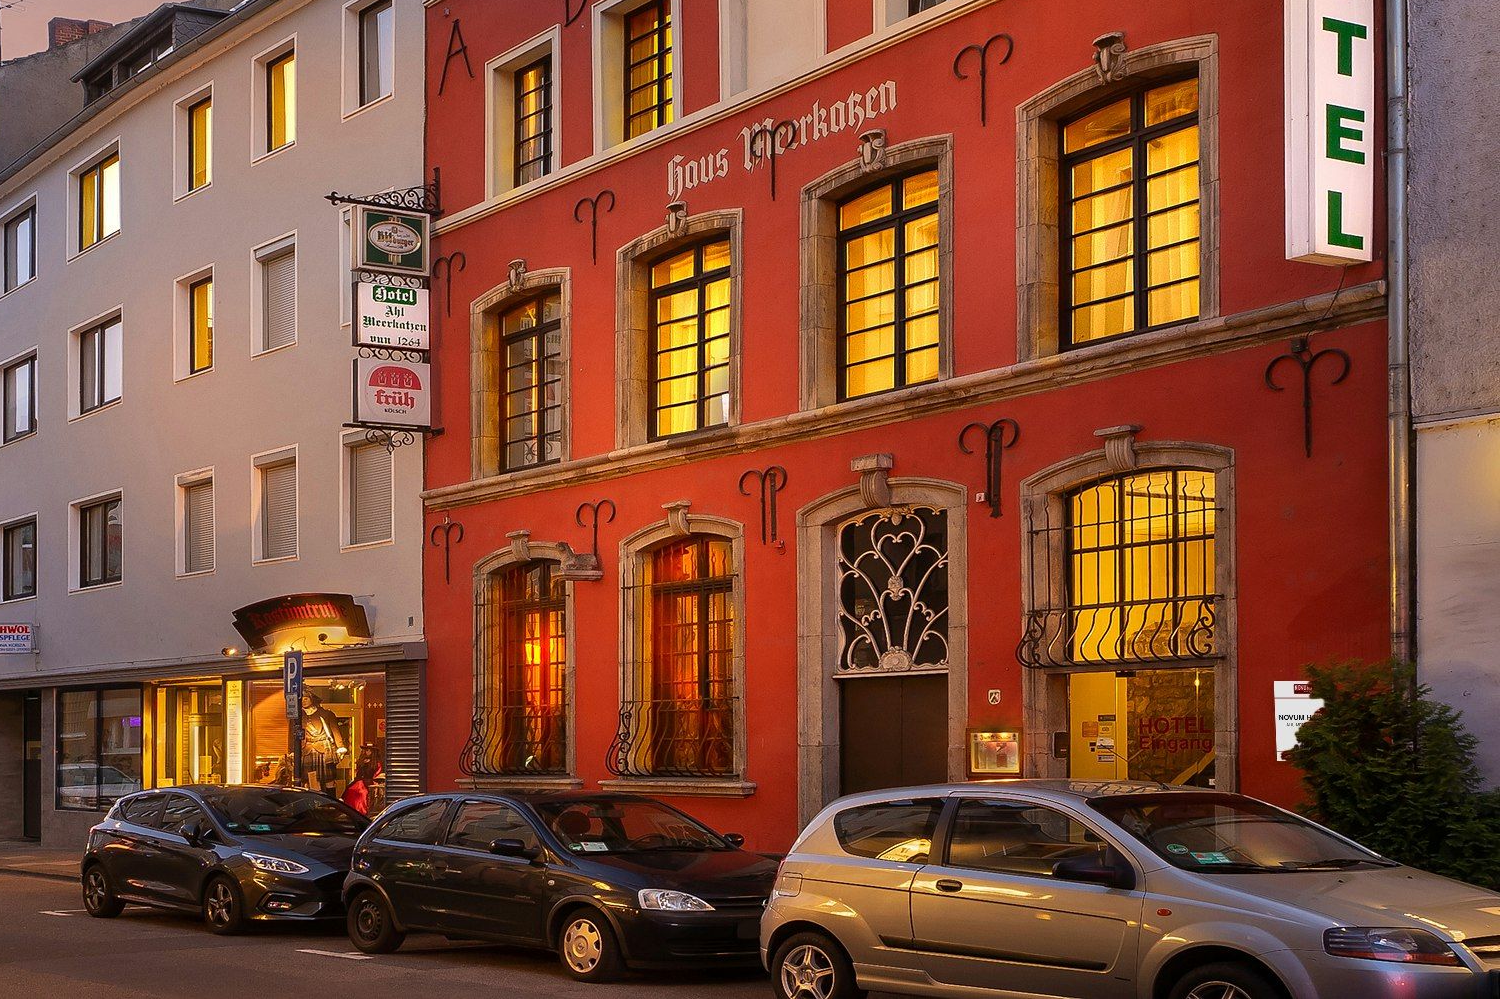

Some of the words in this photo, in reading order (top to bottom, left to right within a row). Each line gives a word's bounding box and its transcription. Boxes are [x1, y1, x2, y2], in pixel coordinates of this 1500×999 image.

[666, 146, 730, 202] Haus
[374, 286, 415, 303] Hotel
[397, 336, 421, 348] 1264
[287, 657, 298, 693] P
[1140, 716, 1213, 734] HOTEL
[1140, 736, 1214, 753] Eingang
